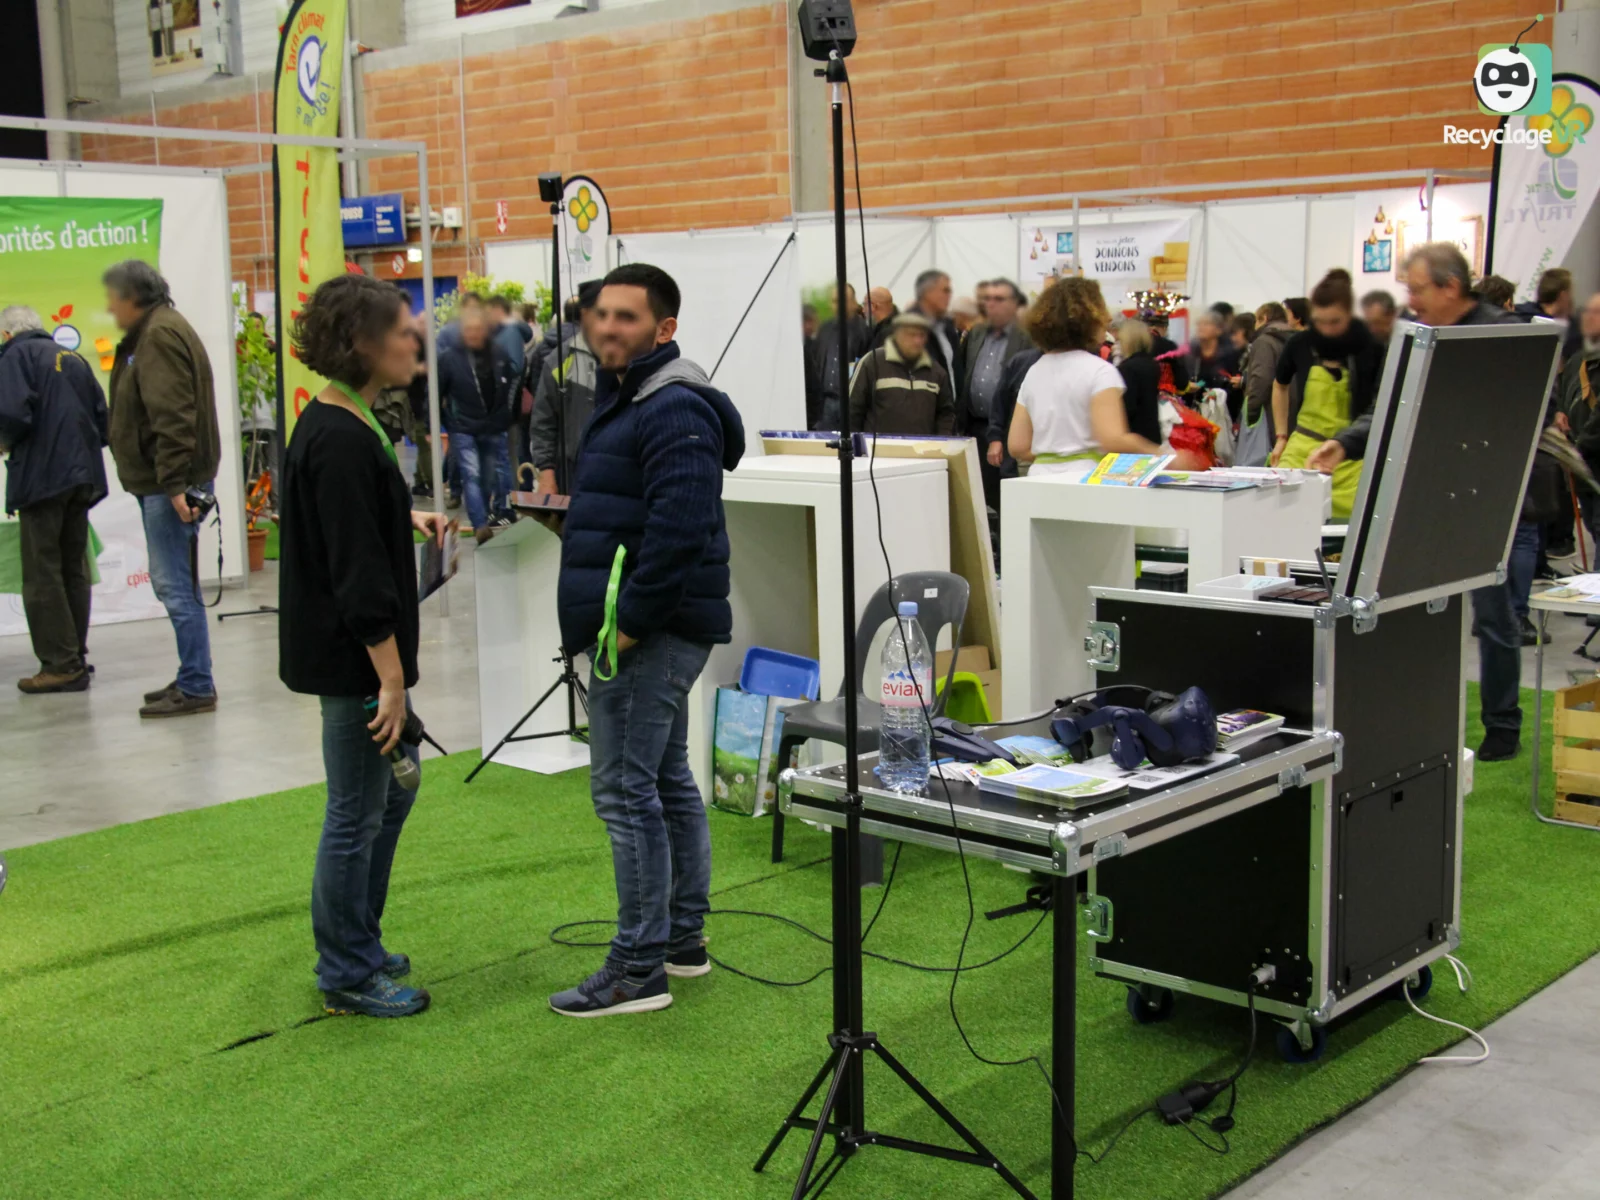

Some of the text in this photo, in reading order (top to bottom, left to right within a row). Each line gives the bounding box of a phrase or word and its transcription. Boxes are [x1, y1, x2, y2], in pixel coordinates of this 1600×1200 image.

[285, 33, 299, 74] Tarn
[60, 219, 137, 249] d'action
[141, 218, 149, 244] !
[1095, 245, 1139, 259] DONNONS
[1094, 259, 1136, 273] VENDONS
[882, 681, 924, 697] evian
